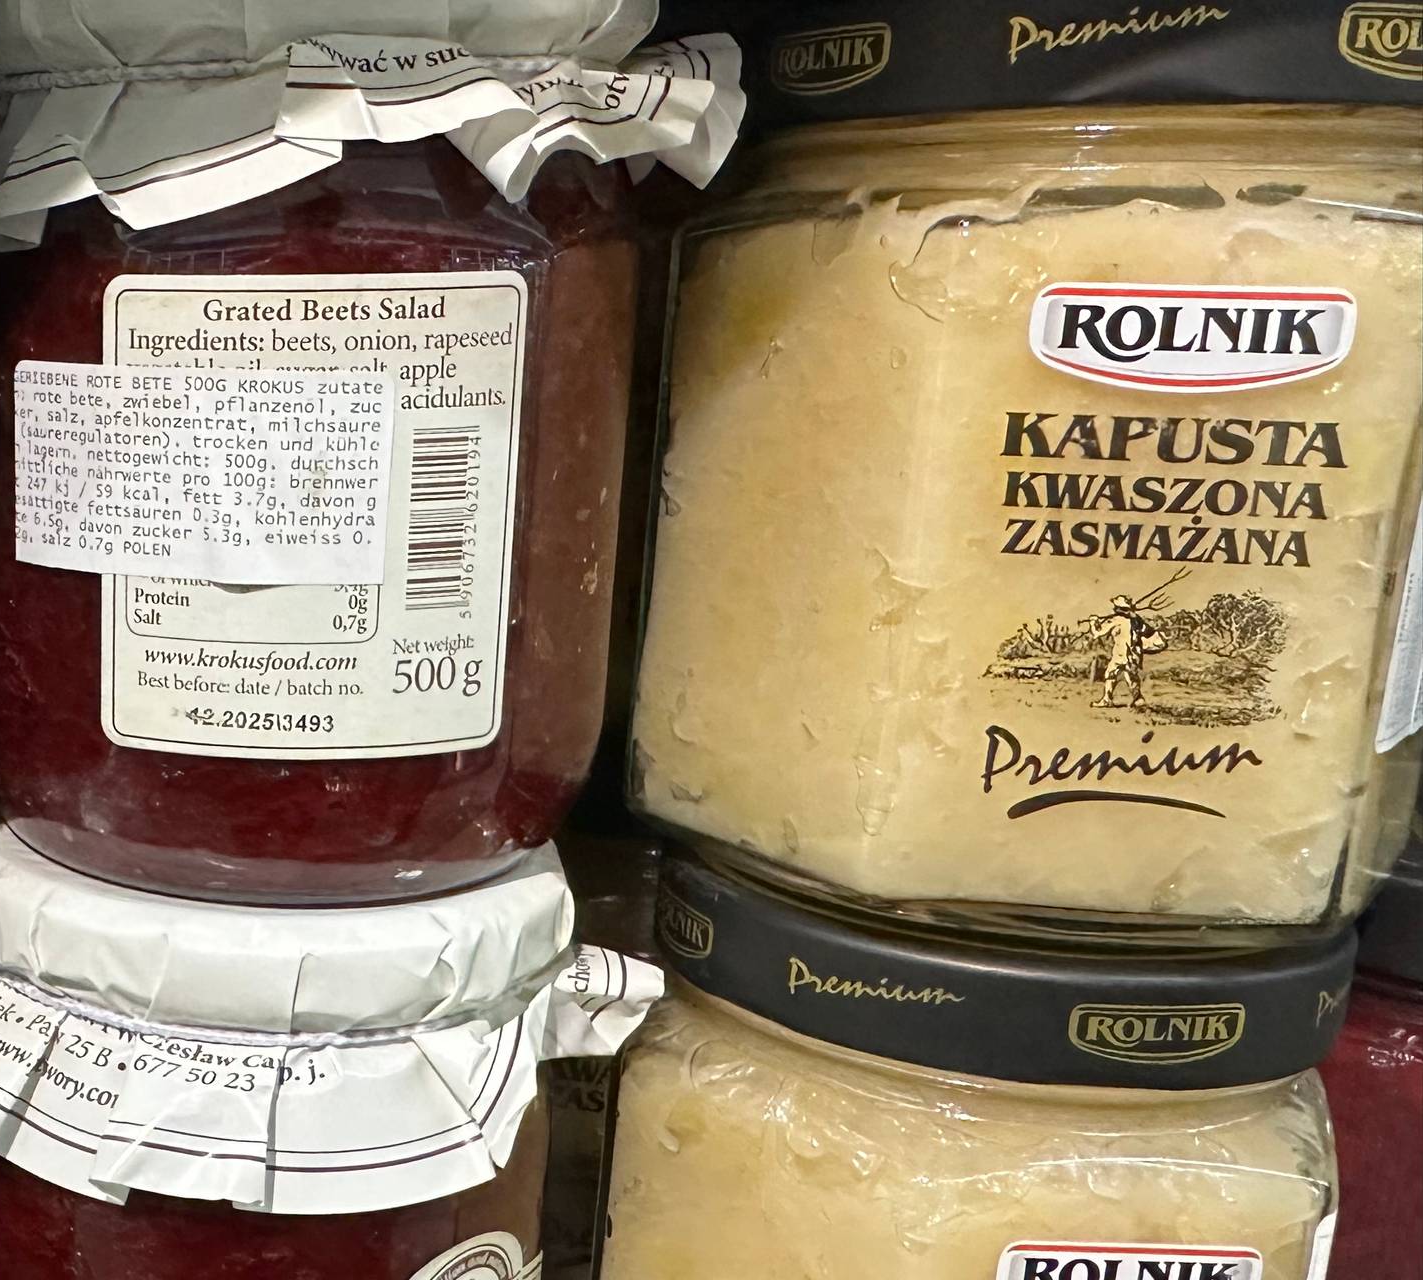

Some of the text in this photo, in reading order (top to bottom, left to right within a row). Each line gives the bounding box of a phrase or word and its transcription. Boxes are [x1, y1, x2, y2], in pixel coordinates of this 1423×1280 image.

[1007, 4, 1230, 66] Premium
[392, 54, 417, 70] w
[778, 36, 876, 79] ROLNIK
[203, 296, 445, 322] Grated Beets Salad
[128, 323, 513, 358] Ingredients: beets, onion, rapeseed
[1057, 304, 1326, 363] ROLNIK
[86, 375, 122, 389] ROTE
[132, 376, 172, 391] BETE
[185, 376, 227, 392] 500G
[238, 379, 304, 394] KROKUS
[317, 381, 383, 395] zutate
[399, 356, 457, 388] apple
[33, 391, 62, 404] rote
[70, 391, 111, 409] bete,
[123, 393, 199, 413] zwiebel,
[349, 401, 382, 414] zuc
[401, 386, 507, 410] acidulants.
[47, 407, 85, 426] salz,
[94, 410, 255, 434] apfelkonzentrat,
[193, 435, 267, 450] trocken
[280, 436, 313, 451] und
[999, 412, 1348, 468] KAPUSTA
[87, 449, 210, 468] nettogewicht:
[291, 456, 379, 471] durchsch
[27, 477, 47, 492] 247
[55, 478, 69, 497] kj
[79, 482, 86, 498] /
[96, 484, 113, 497] 59
[184, 488, 223, 505] fett
[300, 493, 355, 508] davon
[367, 497, 376, 511] g
[183, 473, 210, 486] pro
[223, 473, 276, 491] 100g:
[290, 474, 378, 489] brennwer
[1001, 471, 1327, 520] KWASZONA
[79, 518, 122, 535] davon
[132, 524, 193, 540] zucker
[203, 528, 251, 546] 5.3g,
[265, 530, 341, 545] eiweiss
[193, 508, 375, 529] 0.3g, kohlenhydra
[42, 529, 71, 547] salz
[79, 535, 114, 555] 0.7g
[124, 541, 171, 556] POLEN
[1000, 516, 1311, 567] ZASMAŻANA
[134, 588, 368, 614] Protein 0g
[134, 608, 368, 634] Salt 0,7g
[392, 634, 475, 657] Net weight:
[145, 648, 357, 676] www.krokusfood.com
[138, 671, 365, 696] Best before: date / batch no.
[393, 657, 483, 697] 500 g
[980, 725, 1263, 794] Premium
[788, 957, 965, 1005] Premium
[1085, 1013, 1230, 1049] ROLNIK
[65, 1034, 256, 1092] 25 B 677 50 23
